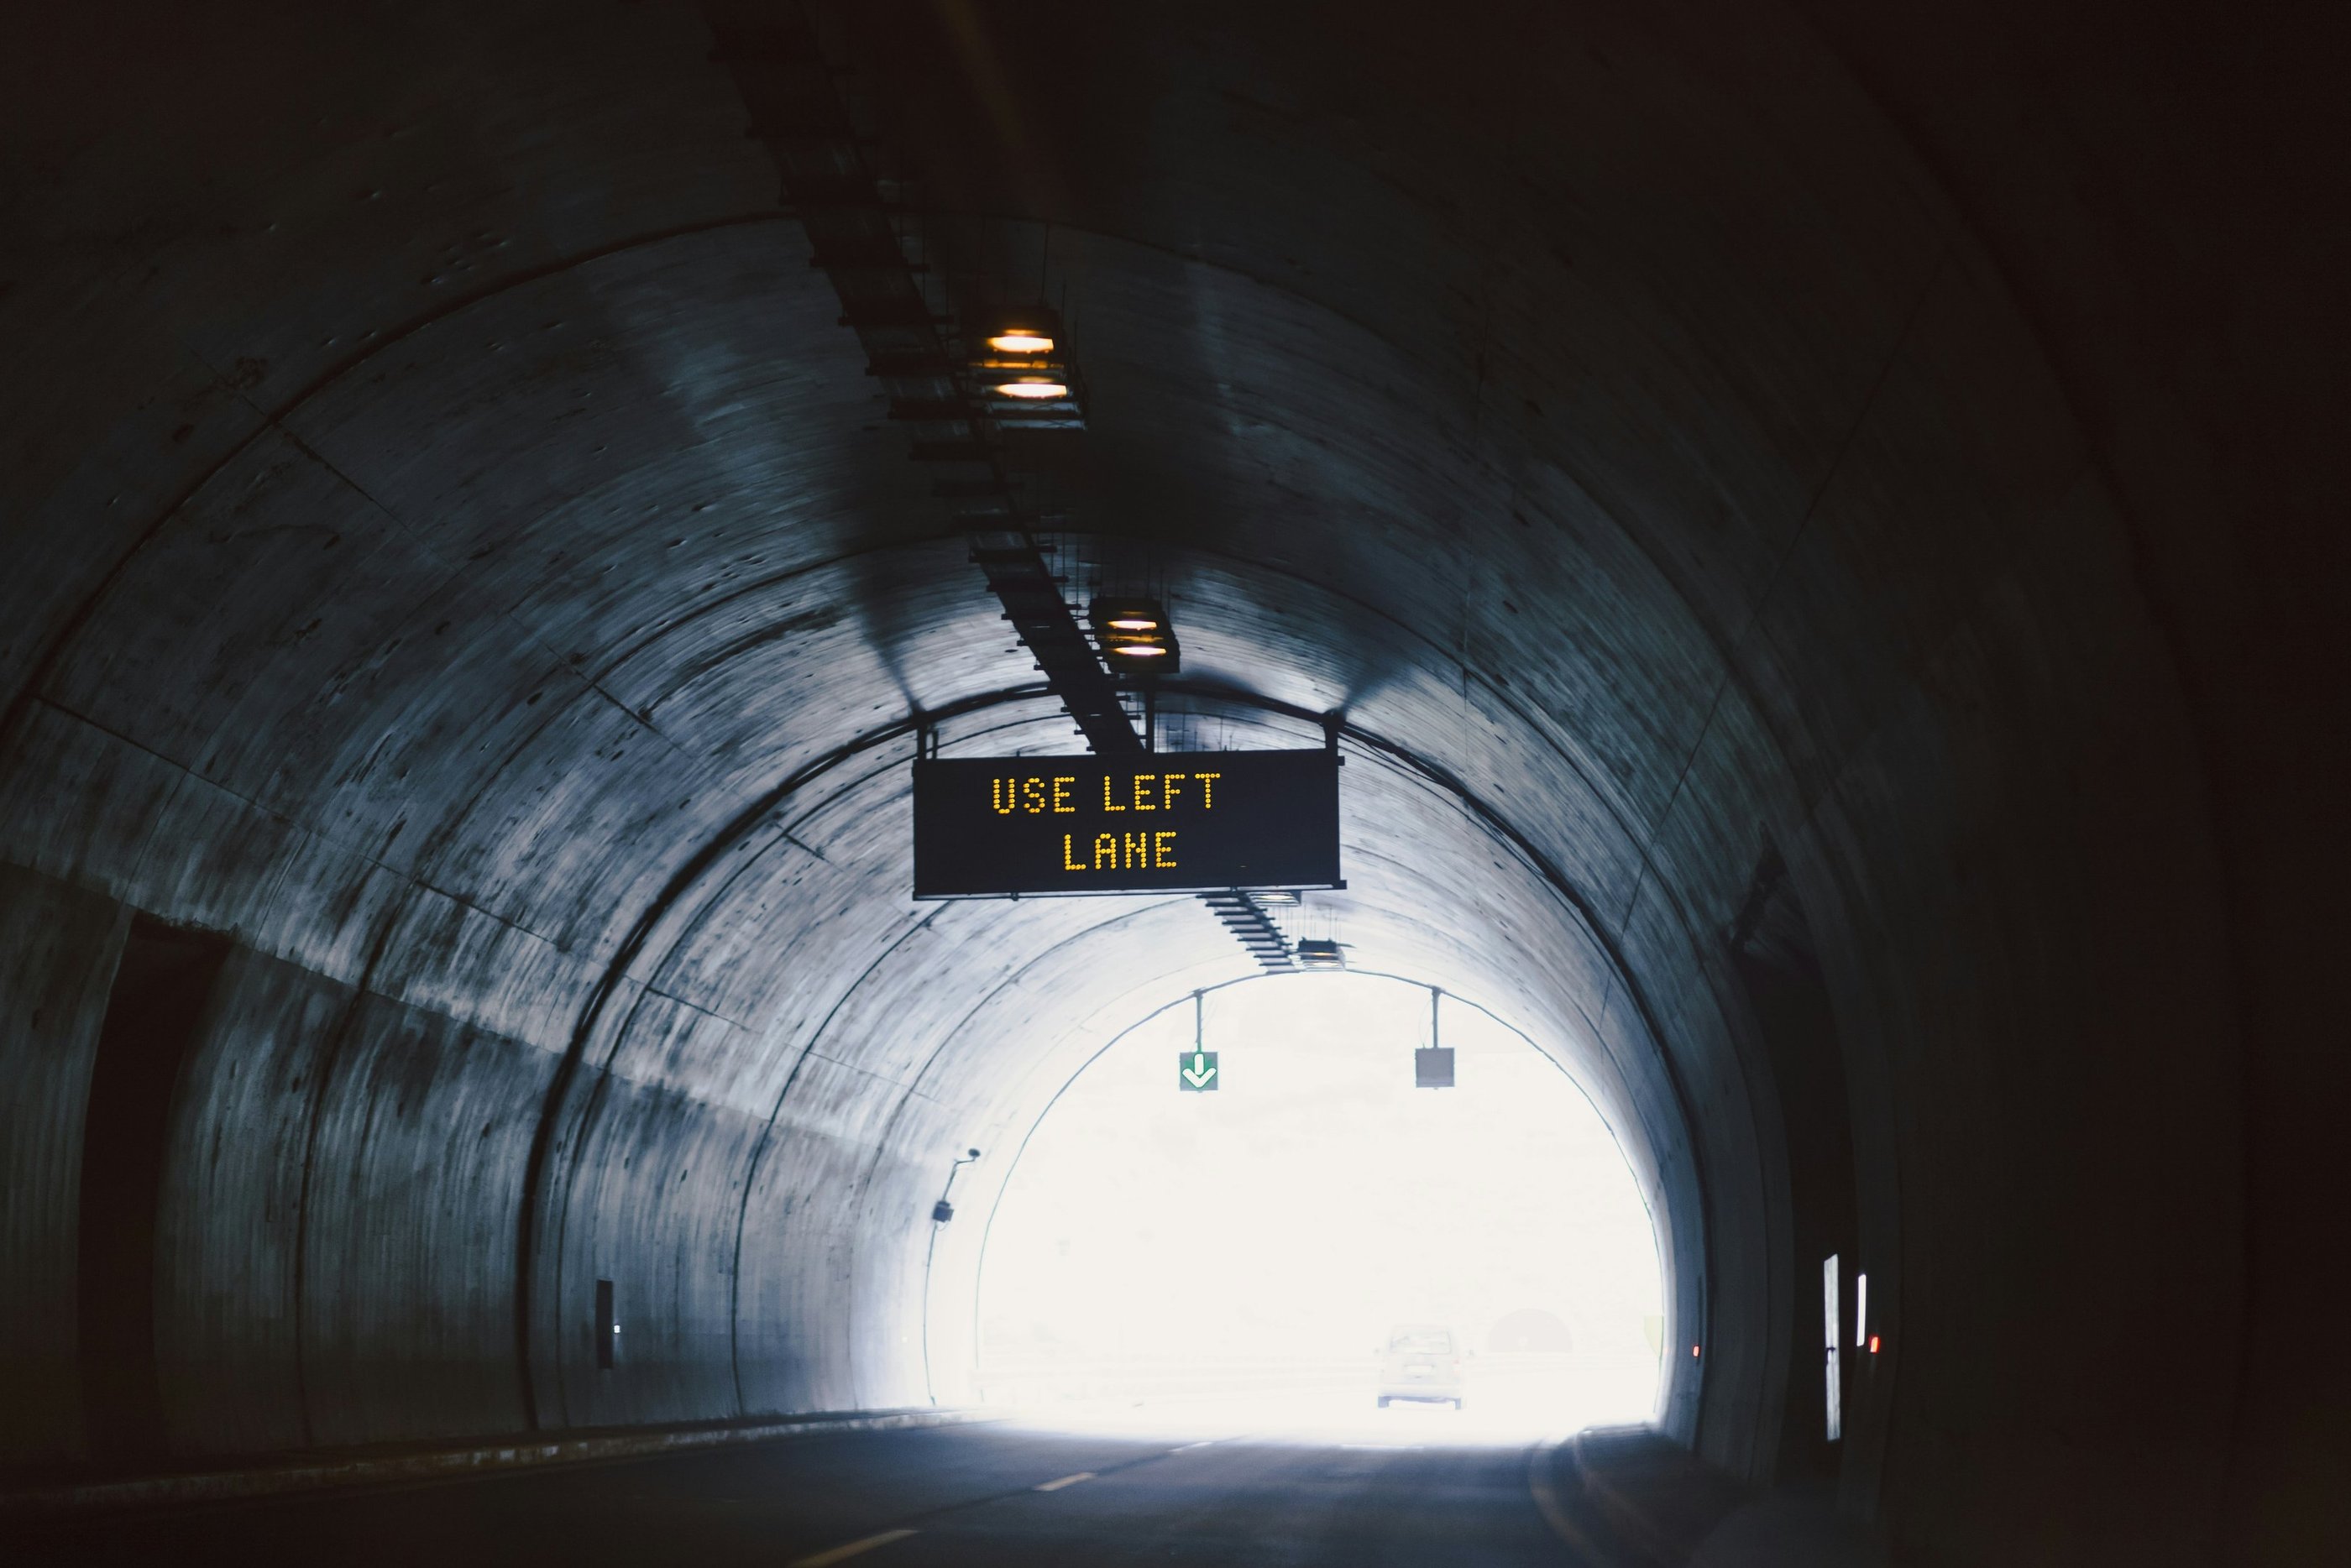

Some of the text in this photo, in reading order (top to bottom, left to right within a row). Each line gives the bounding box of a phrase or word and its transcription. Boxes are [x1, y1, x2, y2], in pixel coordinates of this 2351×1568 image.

[992, 772, 1221, 814] USE LEFT
[1065, 831, 1177, 870] LANE
